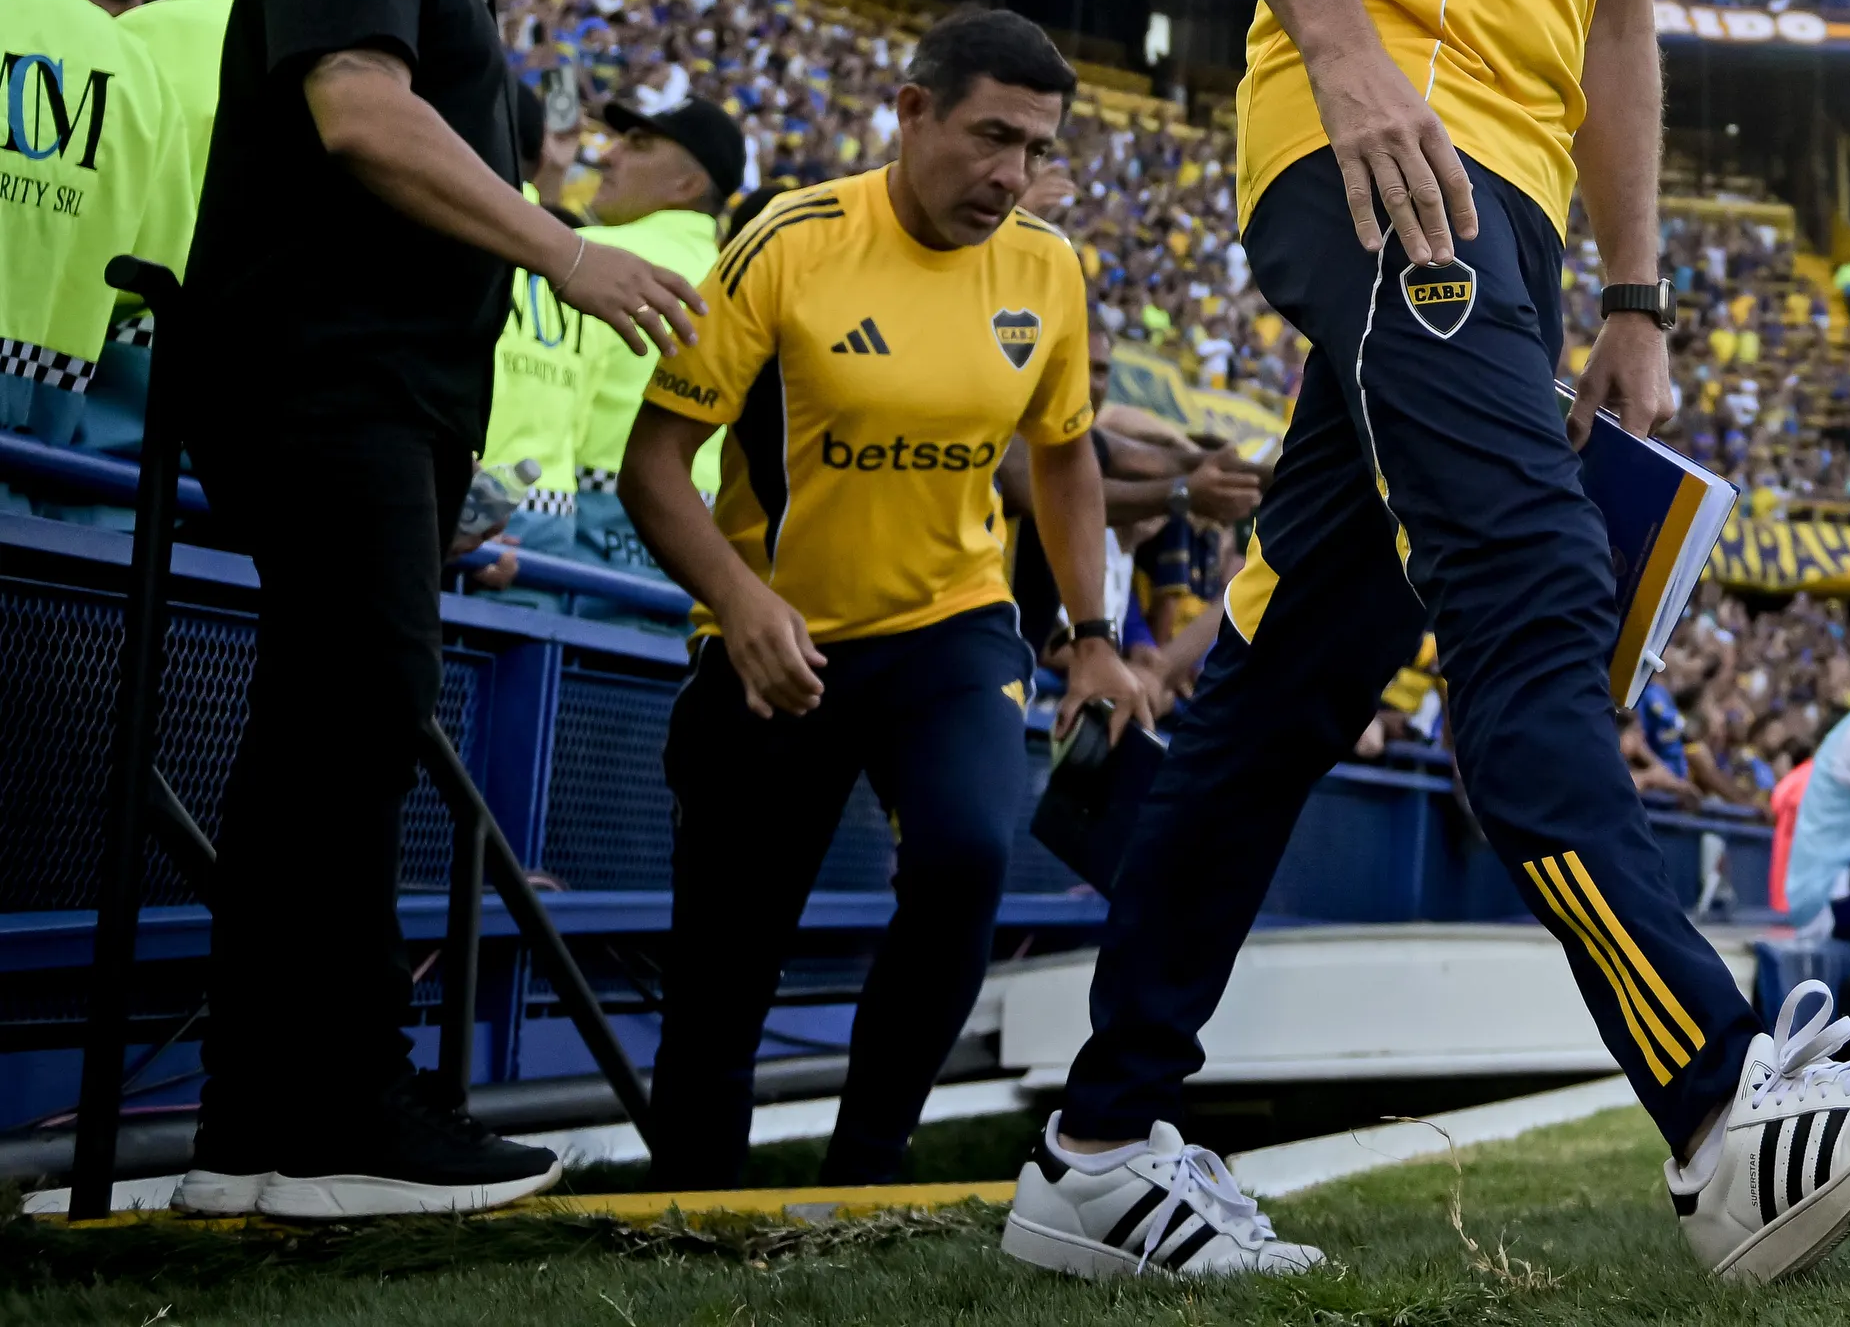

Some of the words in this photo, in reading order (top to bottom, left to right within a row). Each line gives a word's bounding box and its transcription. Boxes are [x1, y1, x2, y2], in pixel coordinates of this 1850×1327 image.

[1414, 284, 1466, 302] CABJ
[656, 367, 719, 409] ROGAR
[822, 432, 995, 471] betsso
[1750, 1153, 1758, 1207] SUPERSTAR
